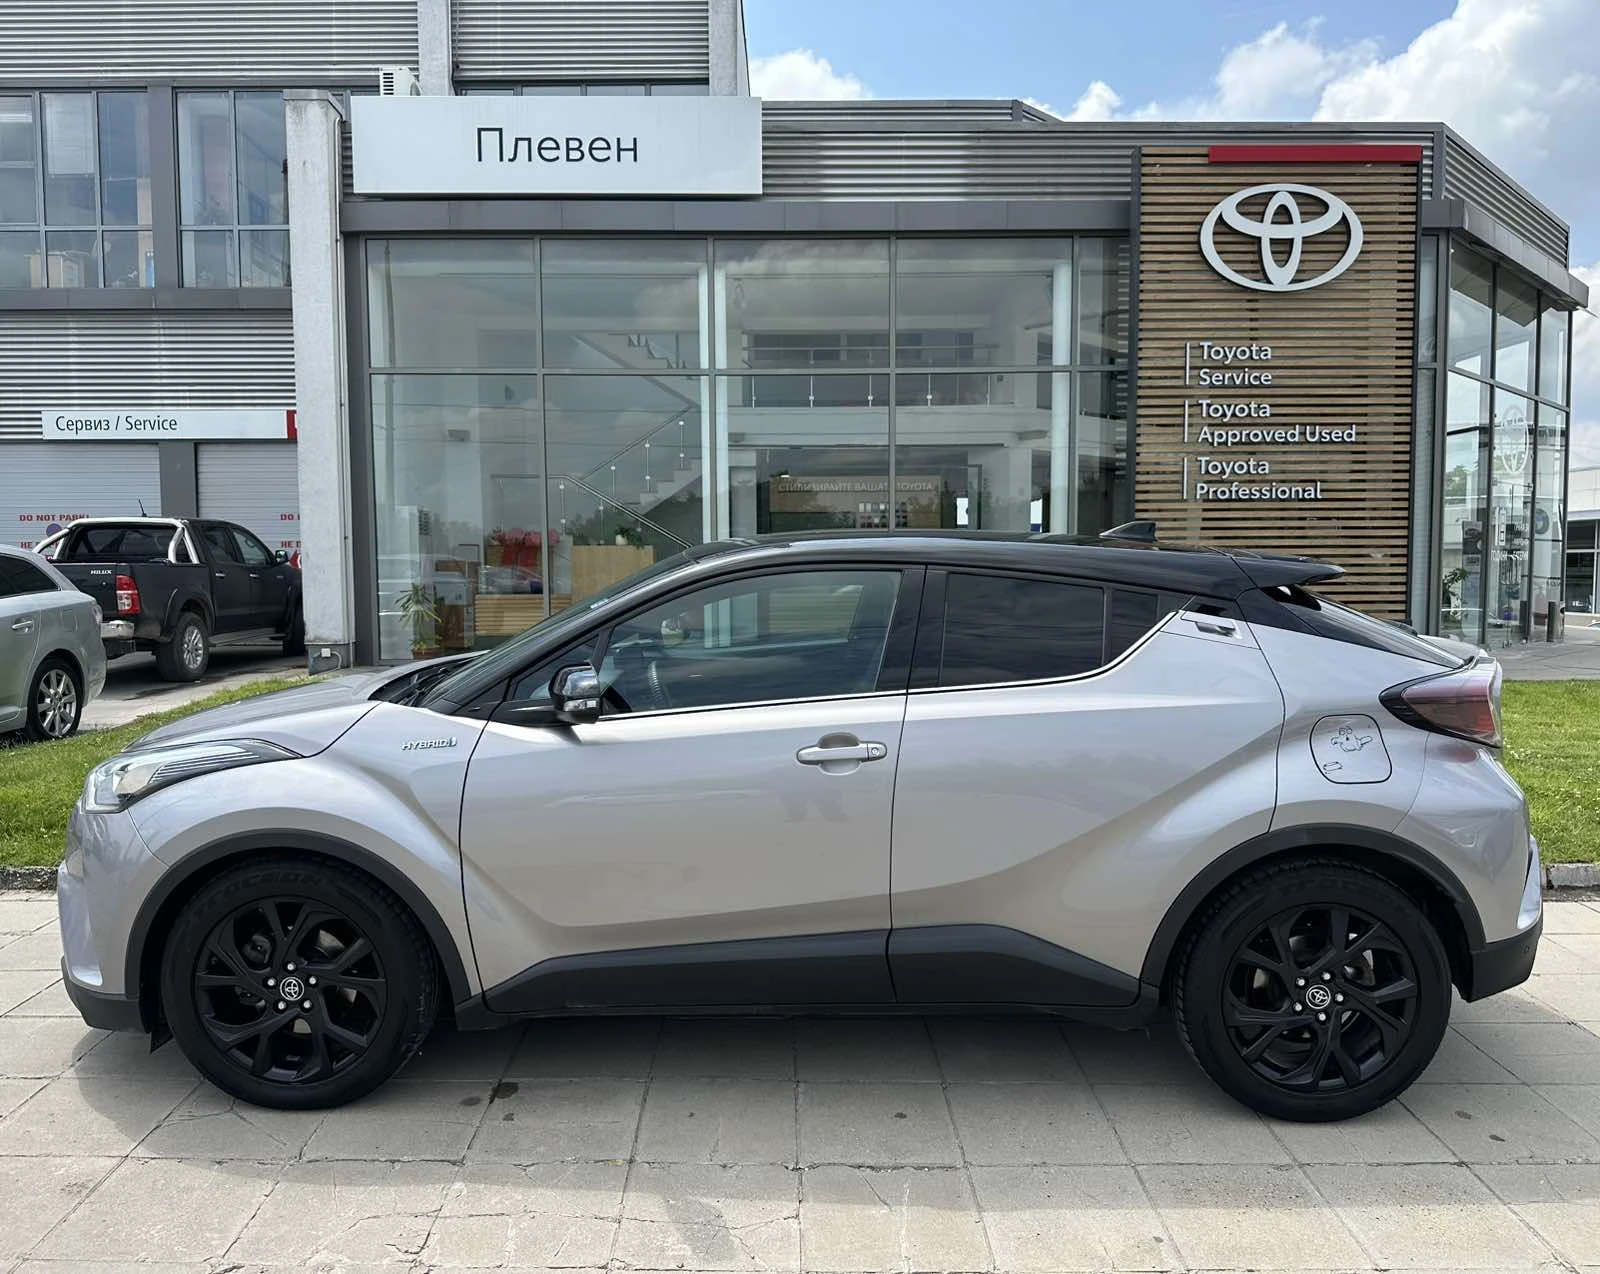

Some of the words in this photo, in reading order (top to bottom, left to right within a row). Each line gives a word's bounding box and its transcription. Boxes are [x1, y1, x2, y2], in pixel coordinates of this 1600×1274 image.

[476, 127, 638, 163] Плевен
[1199, 341, 1272, 364] Toyota
[1199, 368, 1273, 385] Service
[1198, 399, 1271, 422] Toyota
[55, 415, 110, 435] Сервиз
[125, 415, 178, 431] Service
[1198, 424, 1300, 447] Approved
[1305, 424, 1357, 442] Used
[1197, 456, 1270, 479] Toyota
[1196, 481, 1322, 500] Professional
[402, 738, 449, 751] HYBRID
